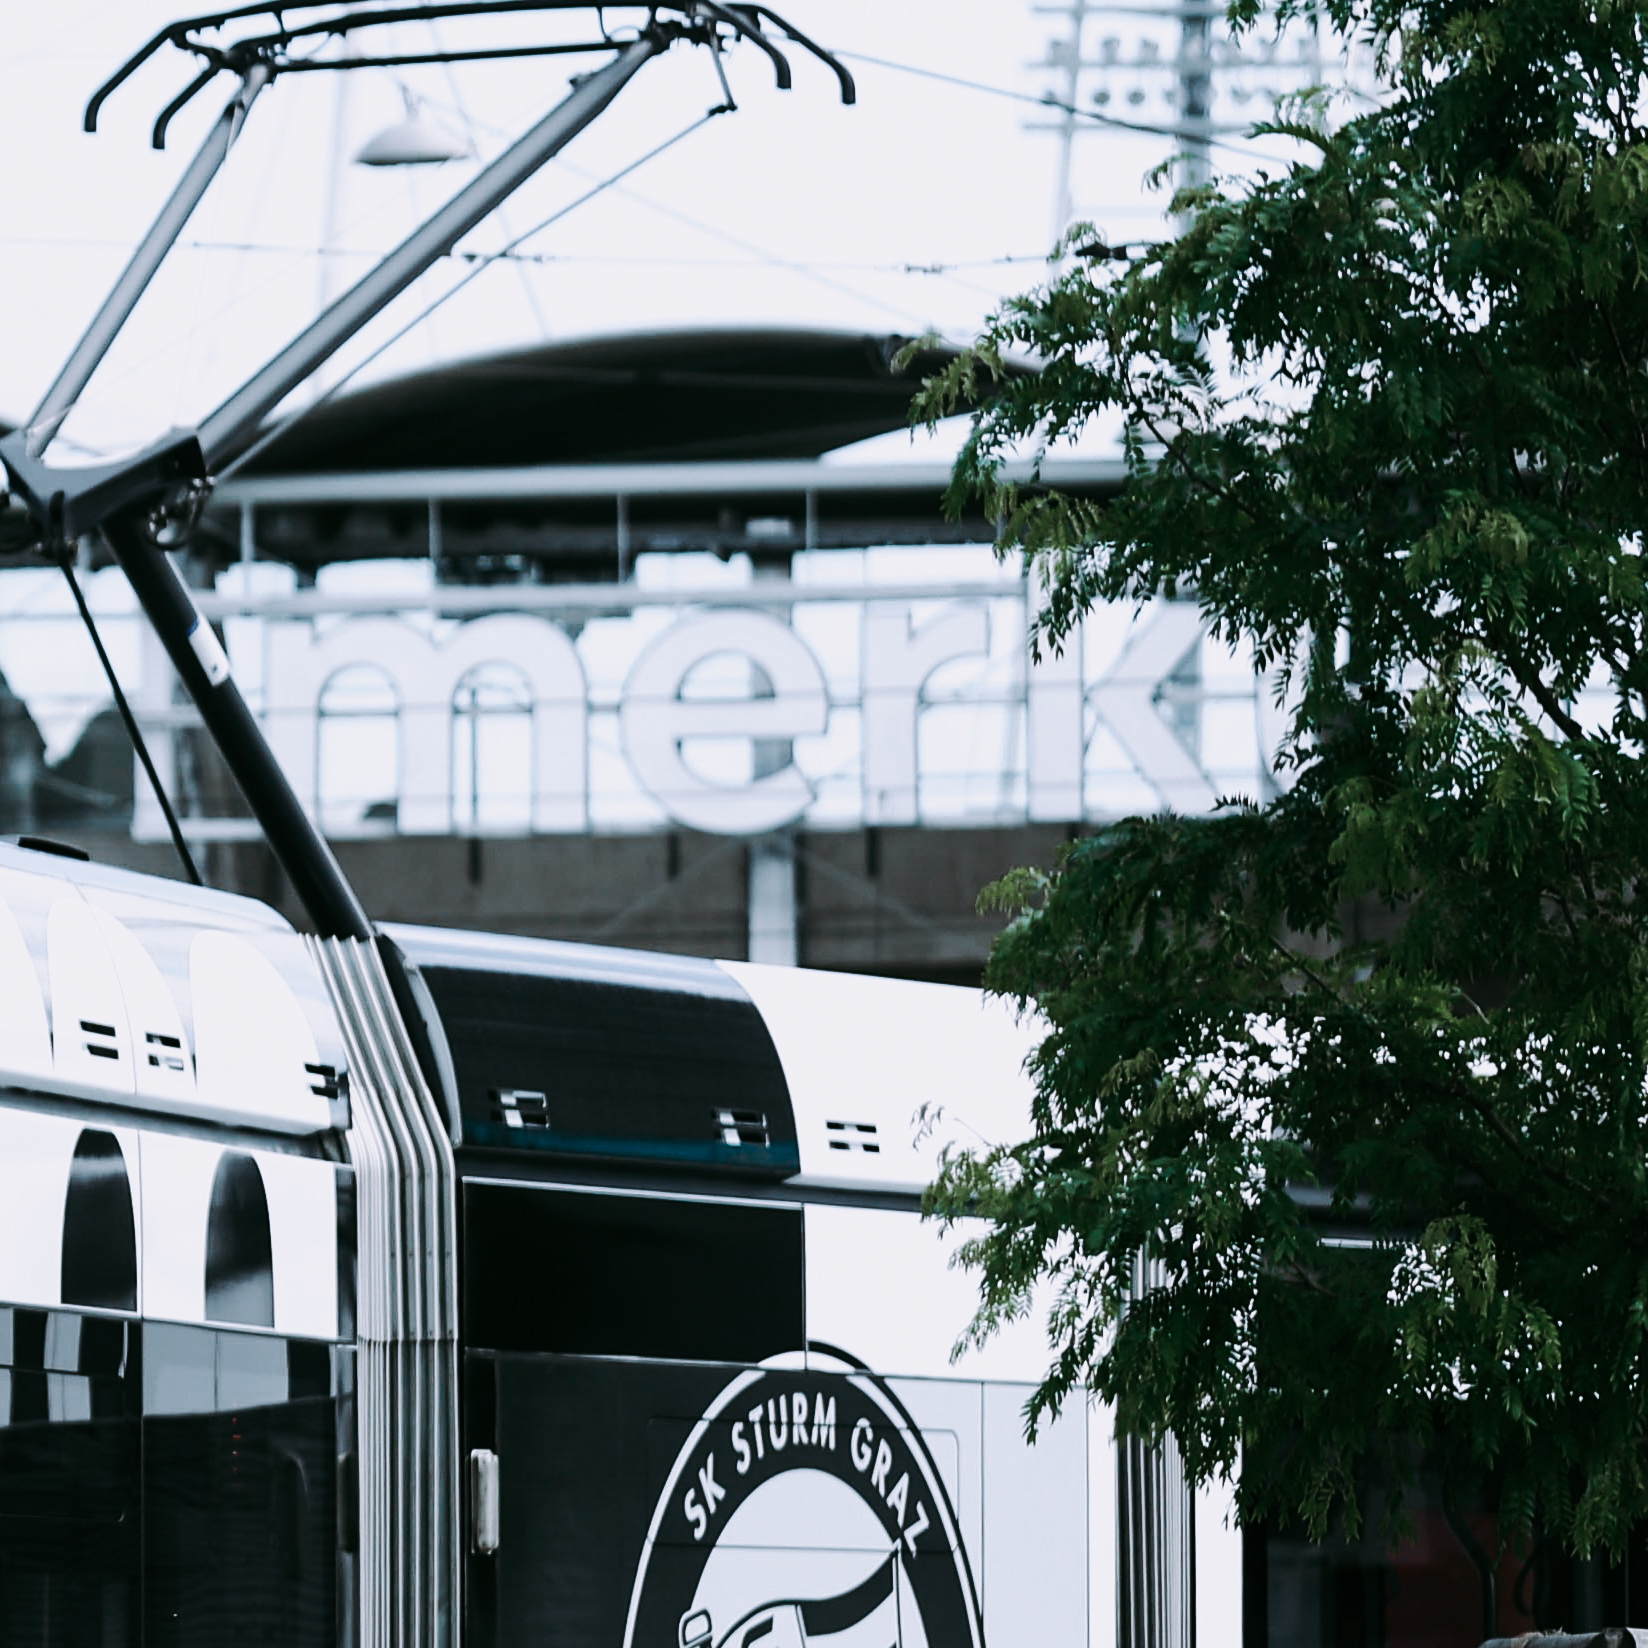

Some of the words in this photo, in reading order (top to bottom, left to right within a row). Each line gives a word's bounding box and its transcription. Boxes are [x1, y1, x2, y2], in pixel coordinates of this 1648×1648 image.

[684, 1456, 729, 1542] SK
[730, 1388, 838, 1467] STURM
[849, 1415, 932, 1557] GRAZ
